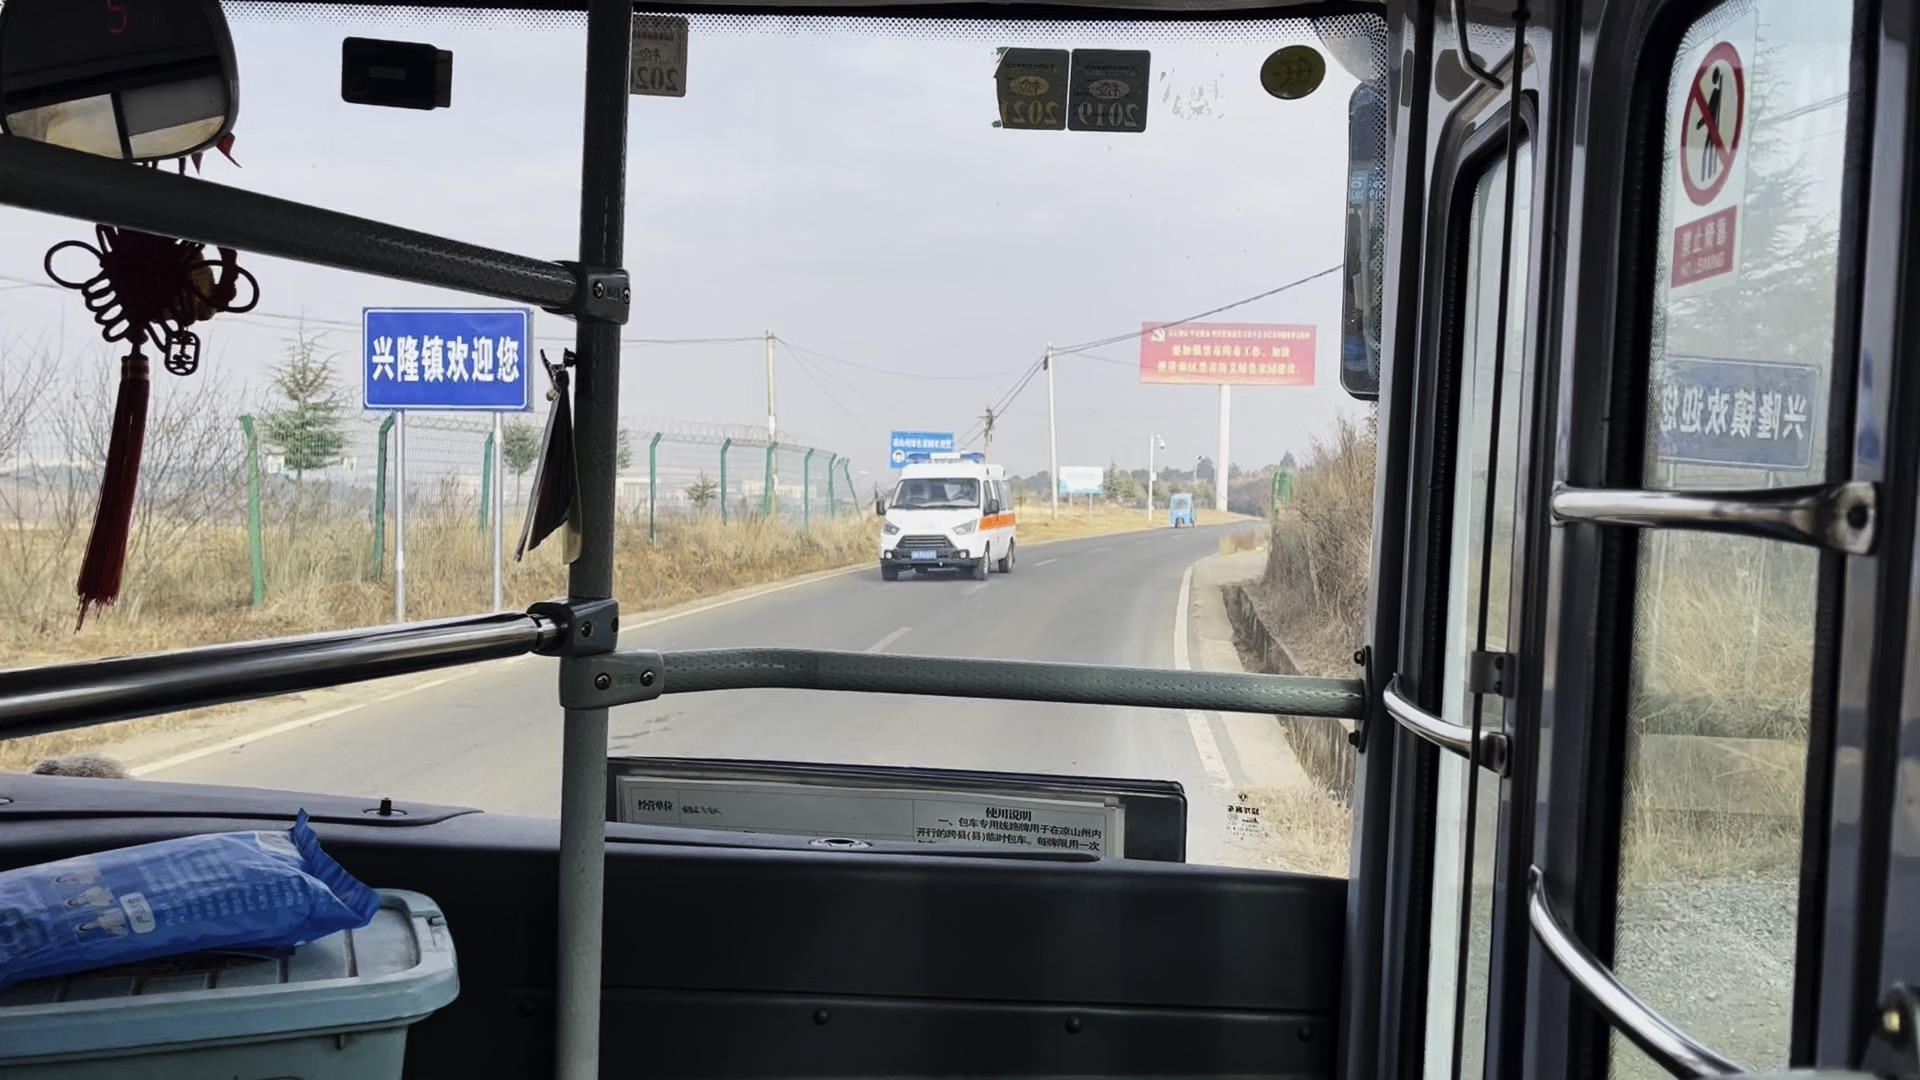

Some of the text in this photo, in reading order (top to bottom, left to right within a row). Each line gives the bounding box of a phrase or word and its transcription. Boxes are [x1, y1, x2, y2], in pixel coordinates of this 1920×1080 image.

[372, 335, 520, 383] 兴隆镇欢迎您
[985, 807, 1032, 821] 使用说明
